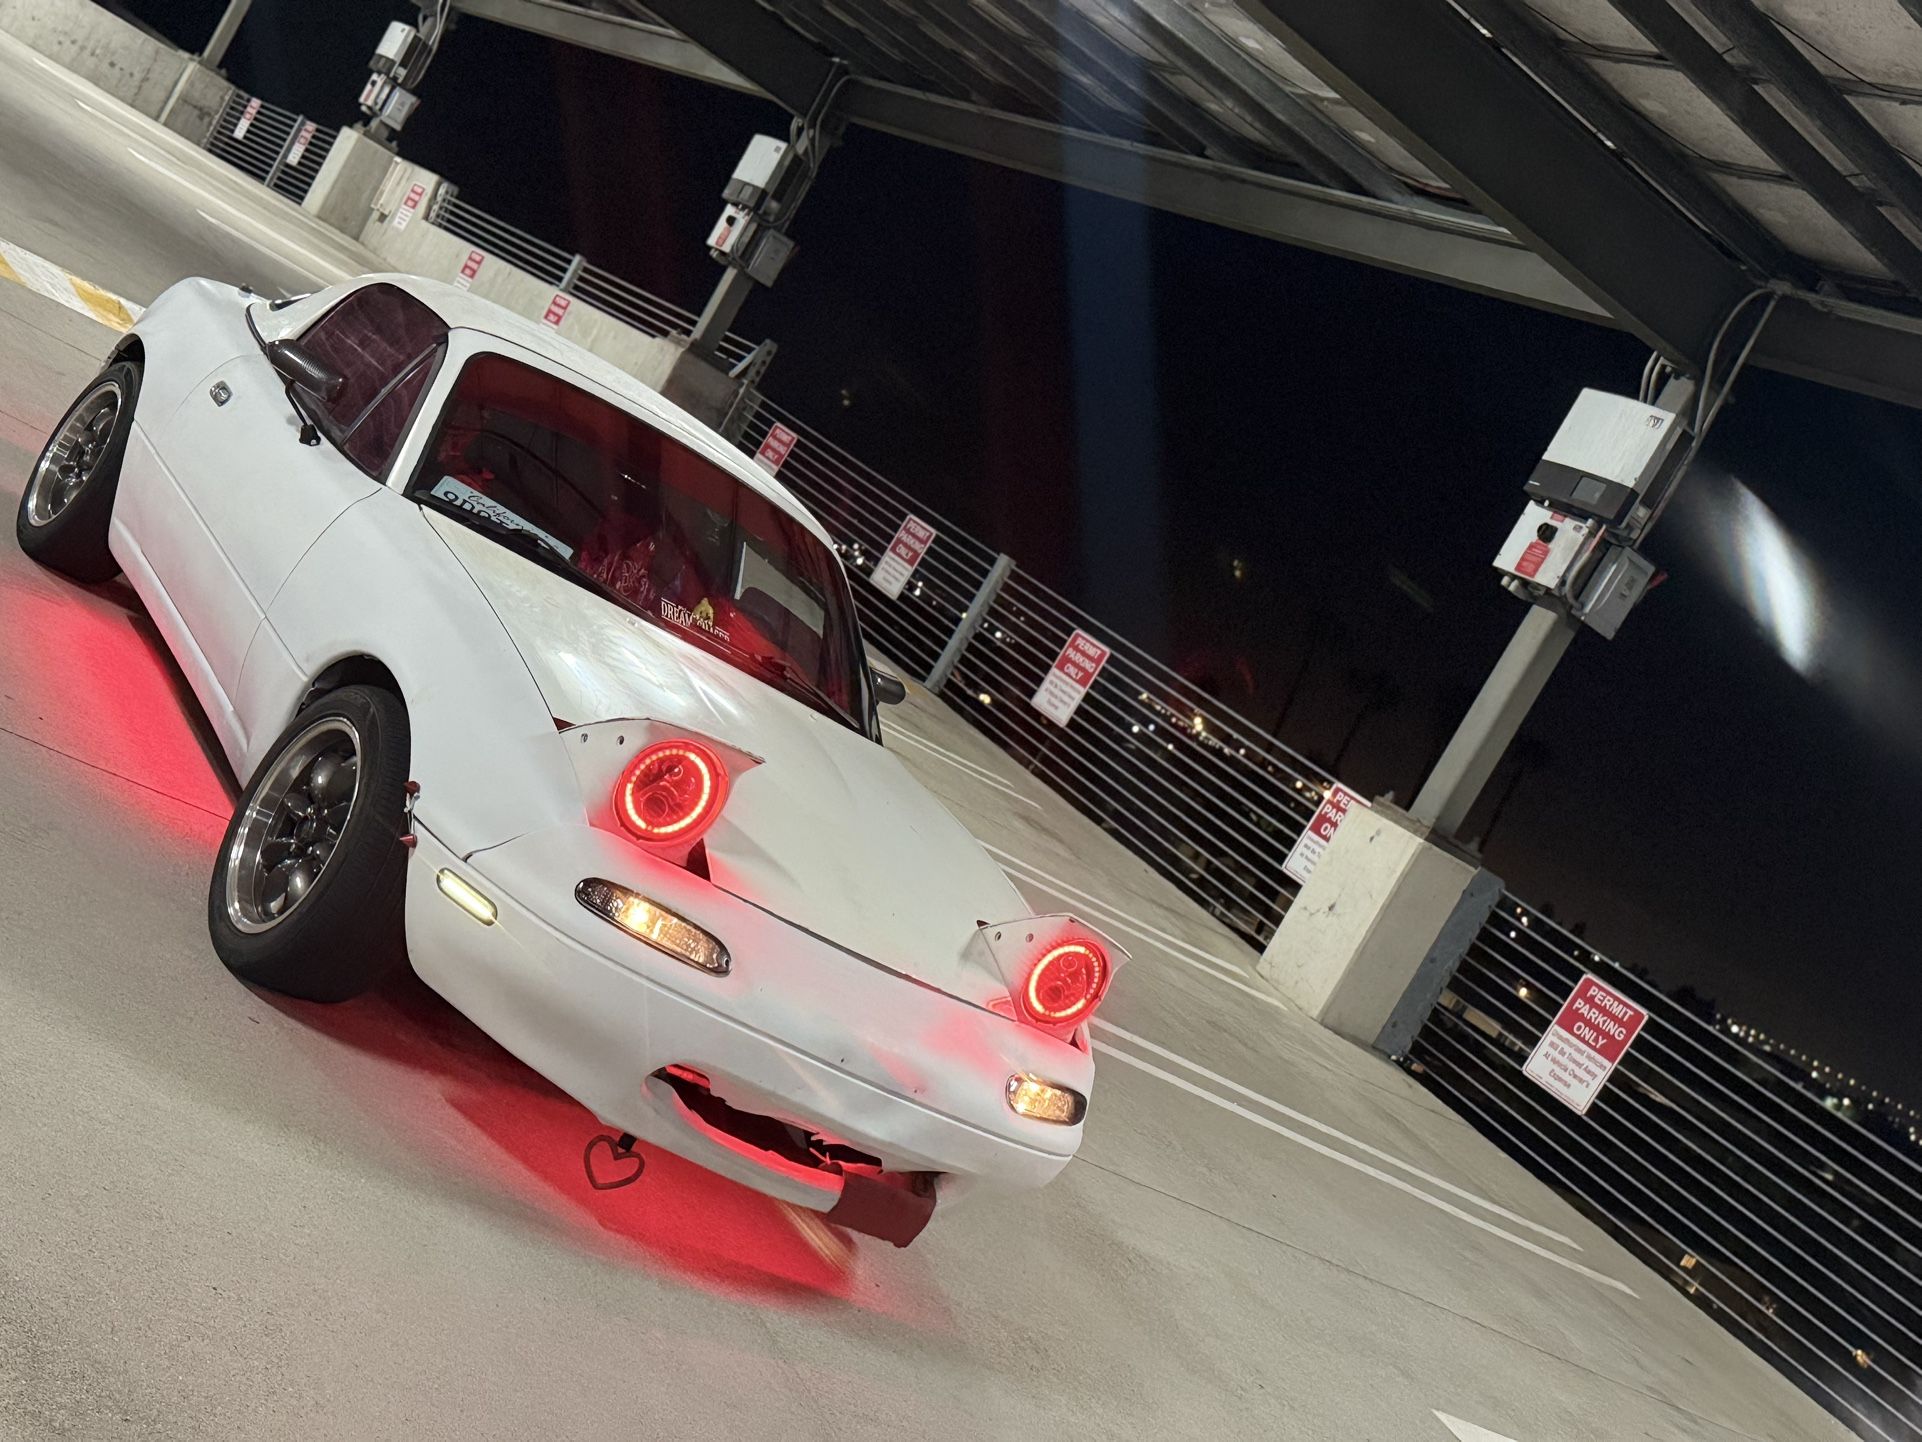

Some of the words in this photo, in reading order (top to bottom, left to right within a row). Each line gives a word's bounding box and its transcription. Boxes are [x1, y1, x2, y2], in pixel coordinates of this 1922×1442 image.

[1064, 663, 1085, 680] ONLY
[1065, 647, 1096, 673] PARKING
[1586, 985, 1634, 1022] PERMIT
[1572, 998, 1626, 1041] PARKING
[1573, 1022, 1608, 1049] ONLY
